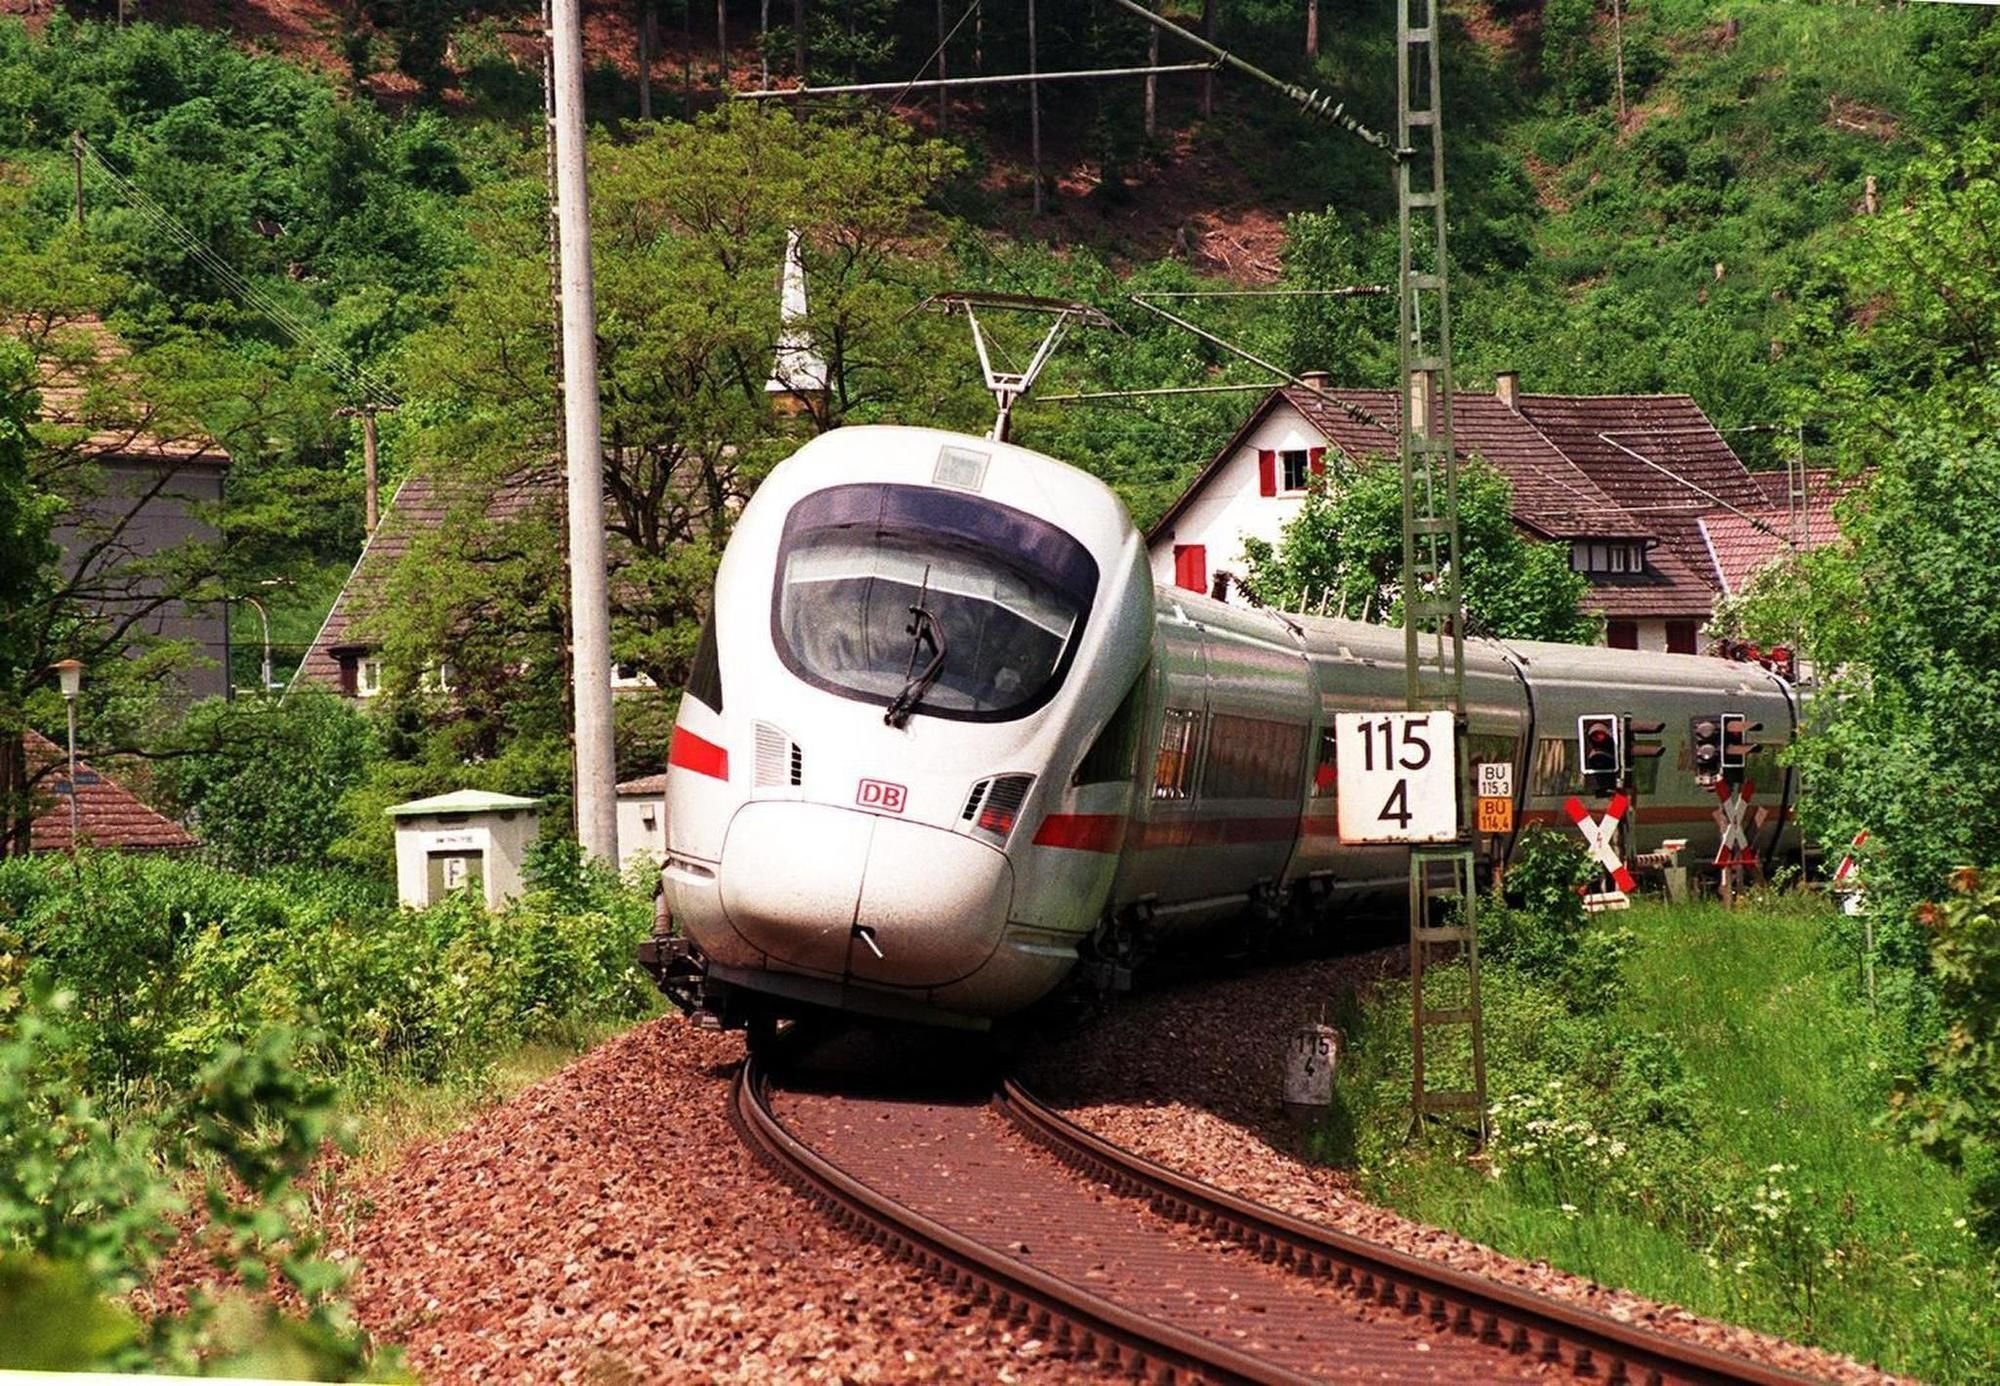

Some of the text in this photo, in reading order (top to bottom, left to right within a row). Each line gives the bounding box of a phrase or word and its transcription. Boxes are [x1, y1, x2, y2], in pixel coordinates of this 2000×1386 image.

[1357, 719, 1431, 771] 115
[863, 783, 900, 807] DB
[1377, 779, 1413, 829] 4
[1297, 1033, 1329, 1056] 115
[1304, 1056, 1316, 1077] 4
